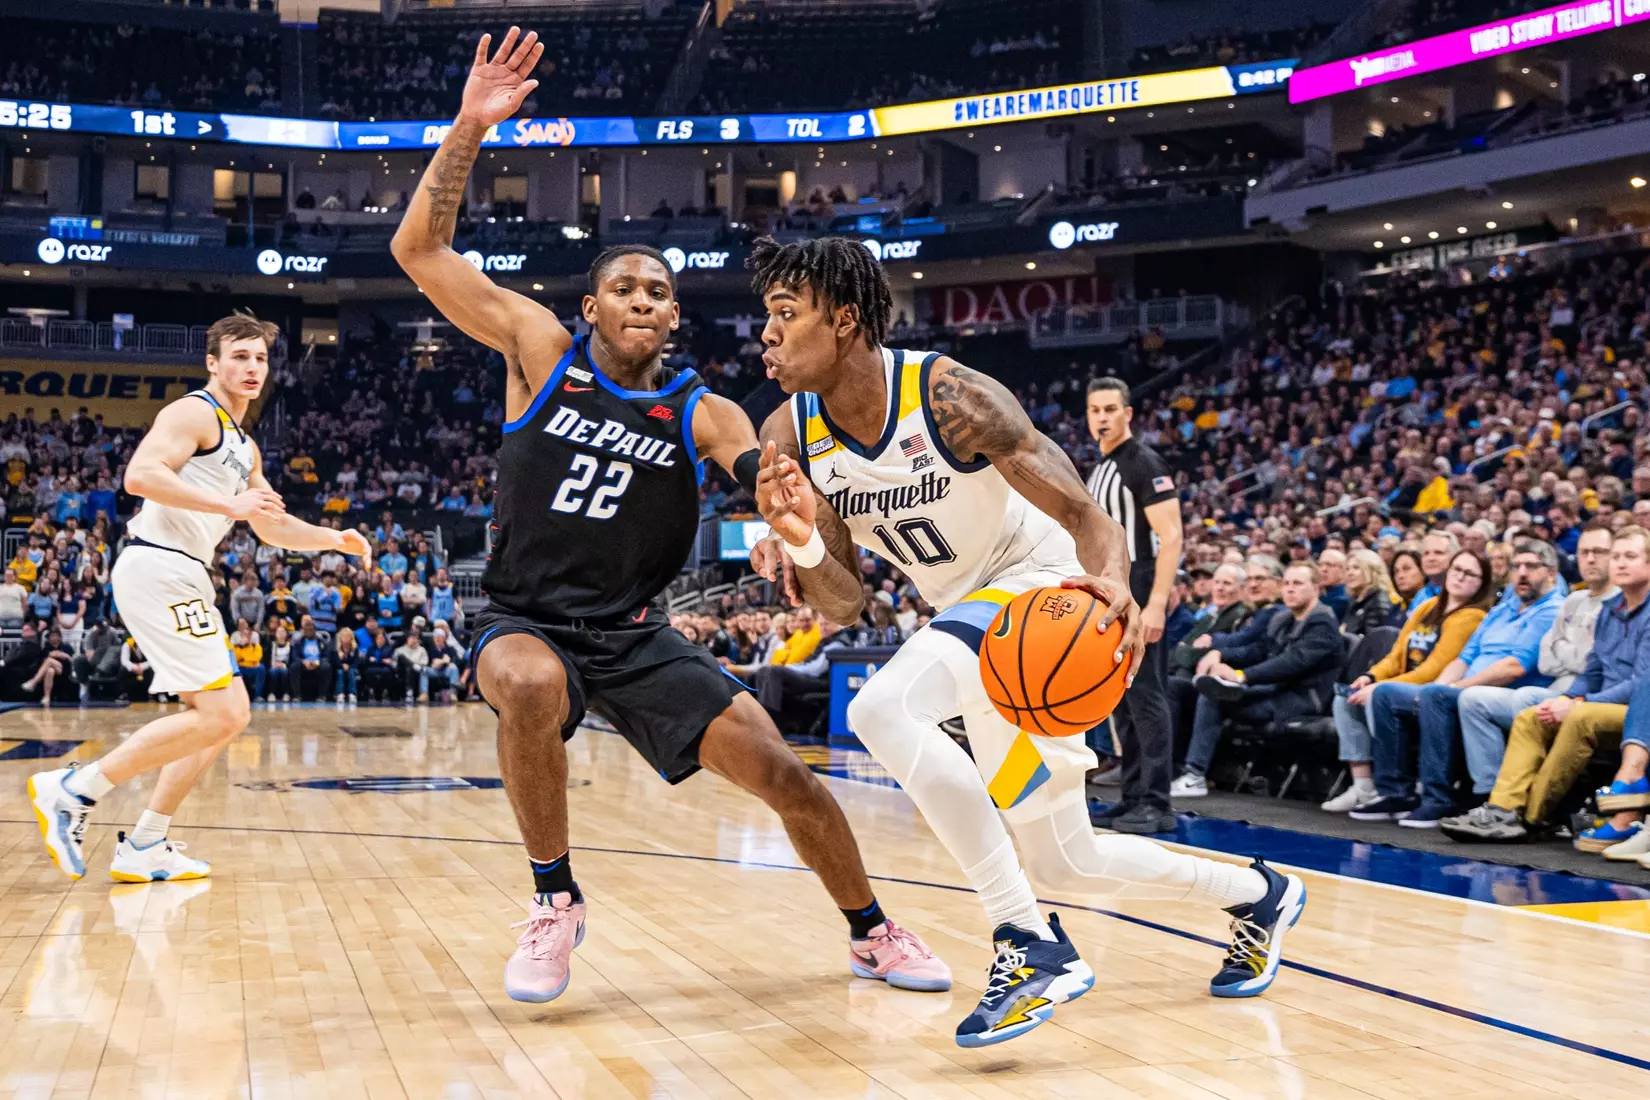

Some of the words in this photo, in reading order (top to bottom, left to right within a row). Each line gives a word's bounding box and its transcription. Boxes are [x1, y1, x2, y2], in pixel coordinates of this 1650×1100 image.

[954, 80, 1139, 121] #WEAREMARQUETTE
[131, 110, 176, 135] 1st
[657, 120, 694, 140] FLS
[720, 118, 740, 140] 3
[786, 118, 823, 137] TOL
[848, 114, 866, 136] 2
[1076, 222, 1119, 242] razr
[67, 244, 112, 261] razr
[688, 251, 730, 268] razr
[882, 240, 922, 258] razr
[285, 255, 328, 273] razr
[485, 253, 527, 271] razr
[551, 453, 634, 520] 22
[825, 470, 951, 519] Marquette
[873, 517, 957, 567] 10
[170, 599, 218, 637] MU
